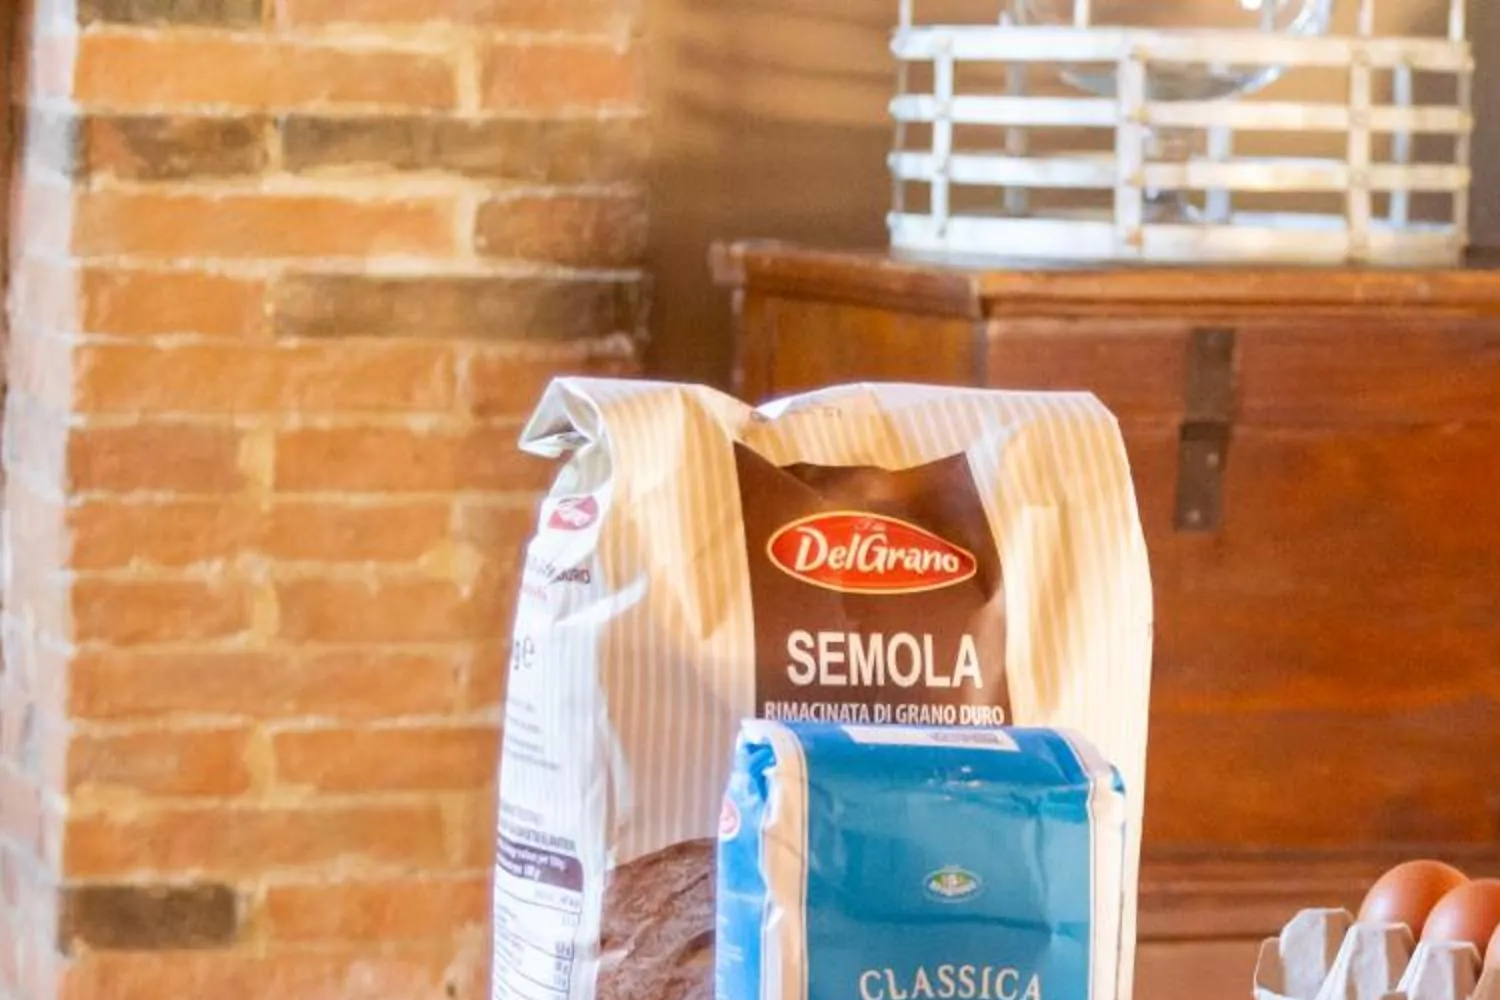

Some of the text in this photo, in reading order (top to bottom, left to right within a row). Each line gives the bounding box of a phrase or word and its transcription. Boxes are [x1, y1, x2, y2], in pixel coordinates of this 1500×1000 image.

[786, 630, 984, 689] SEMOLA
[765, 701, 1005, 726] RIMACINATA DI GRANO DURO
